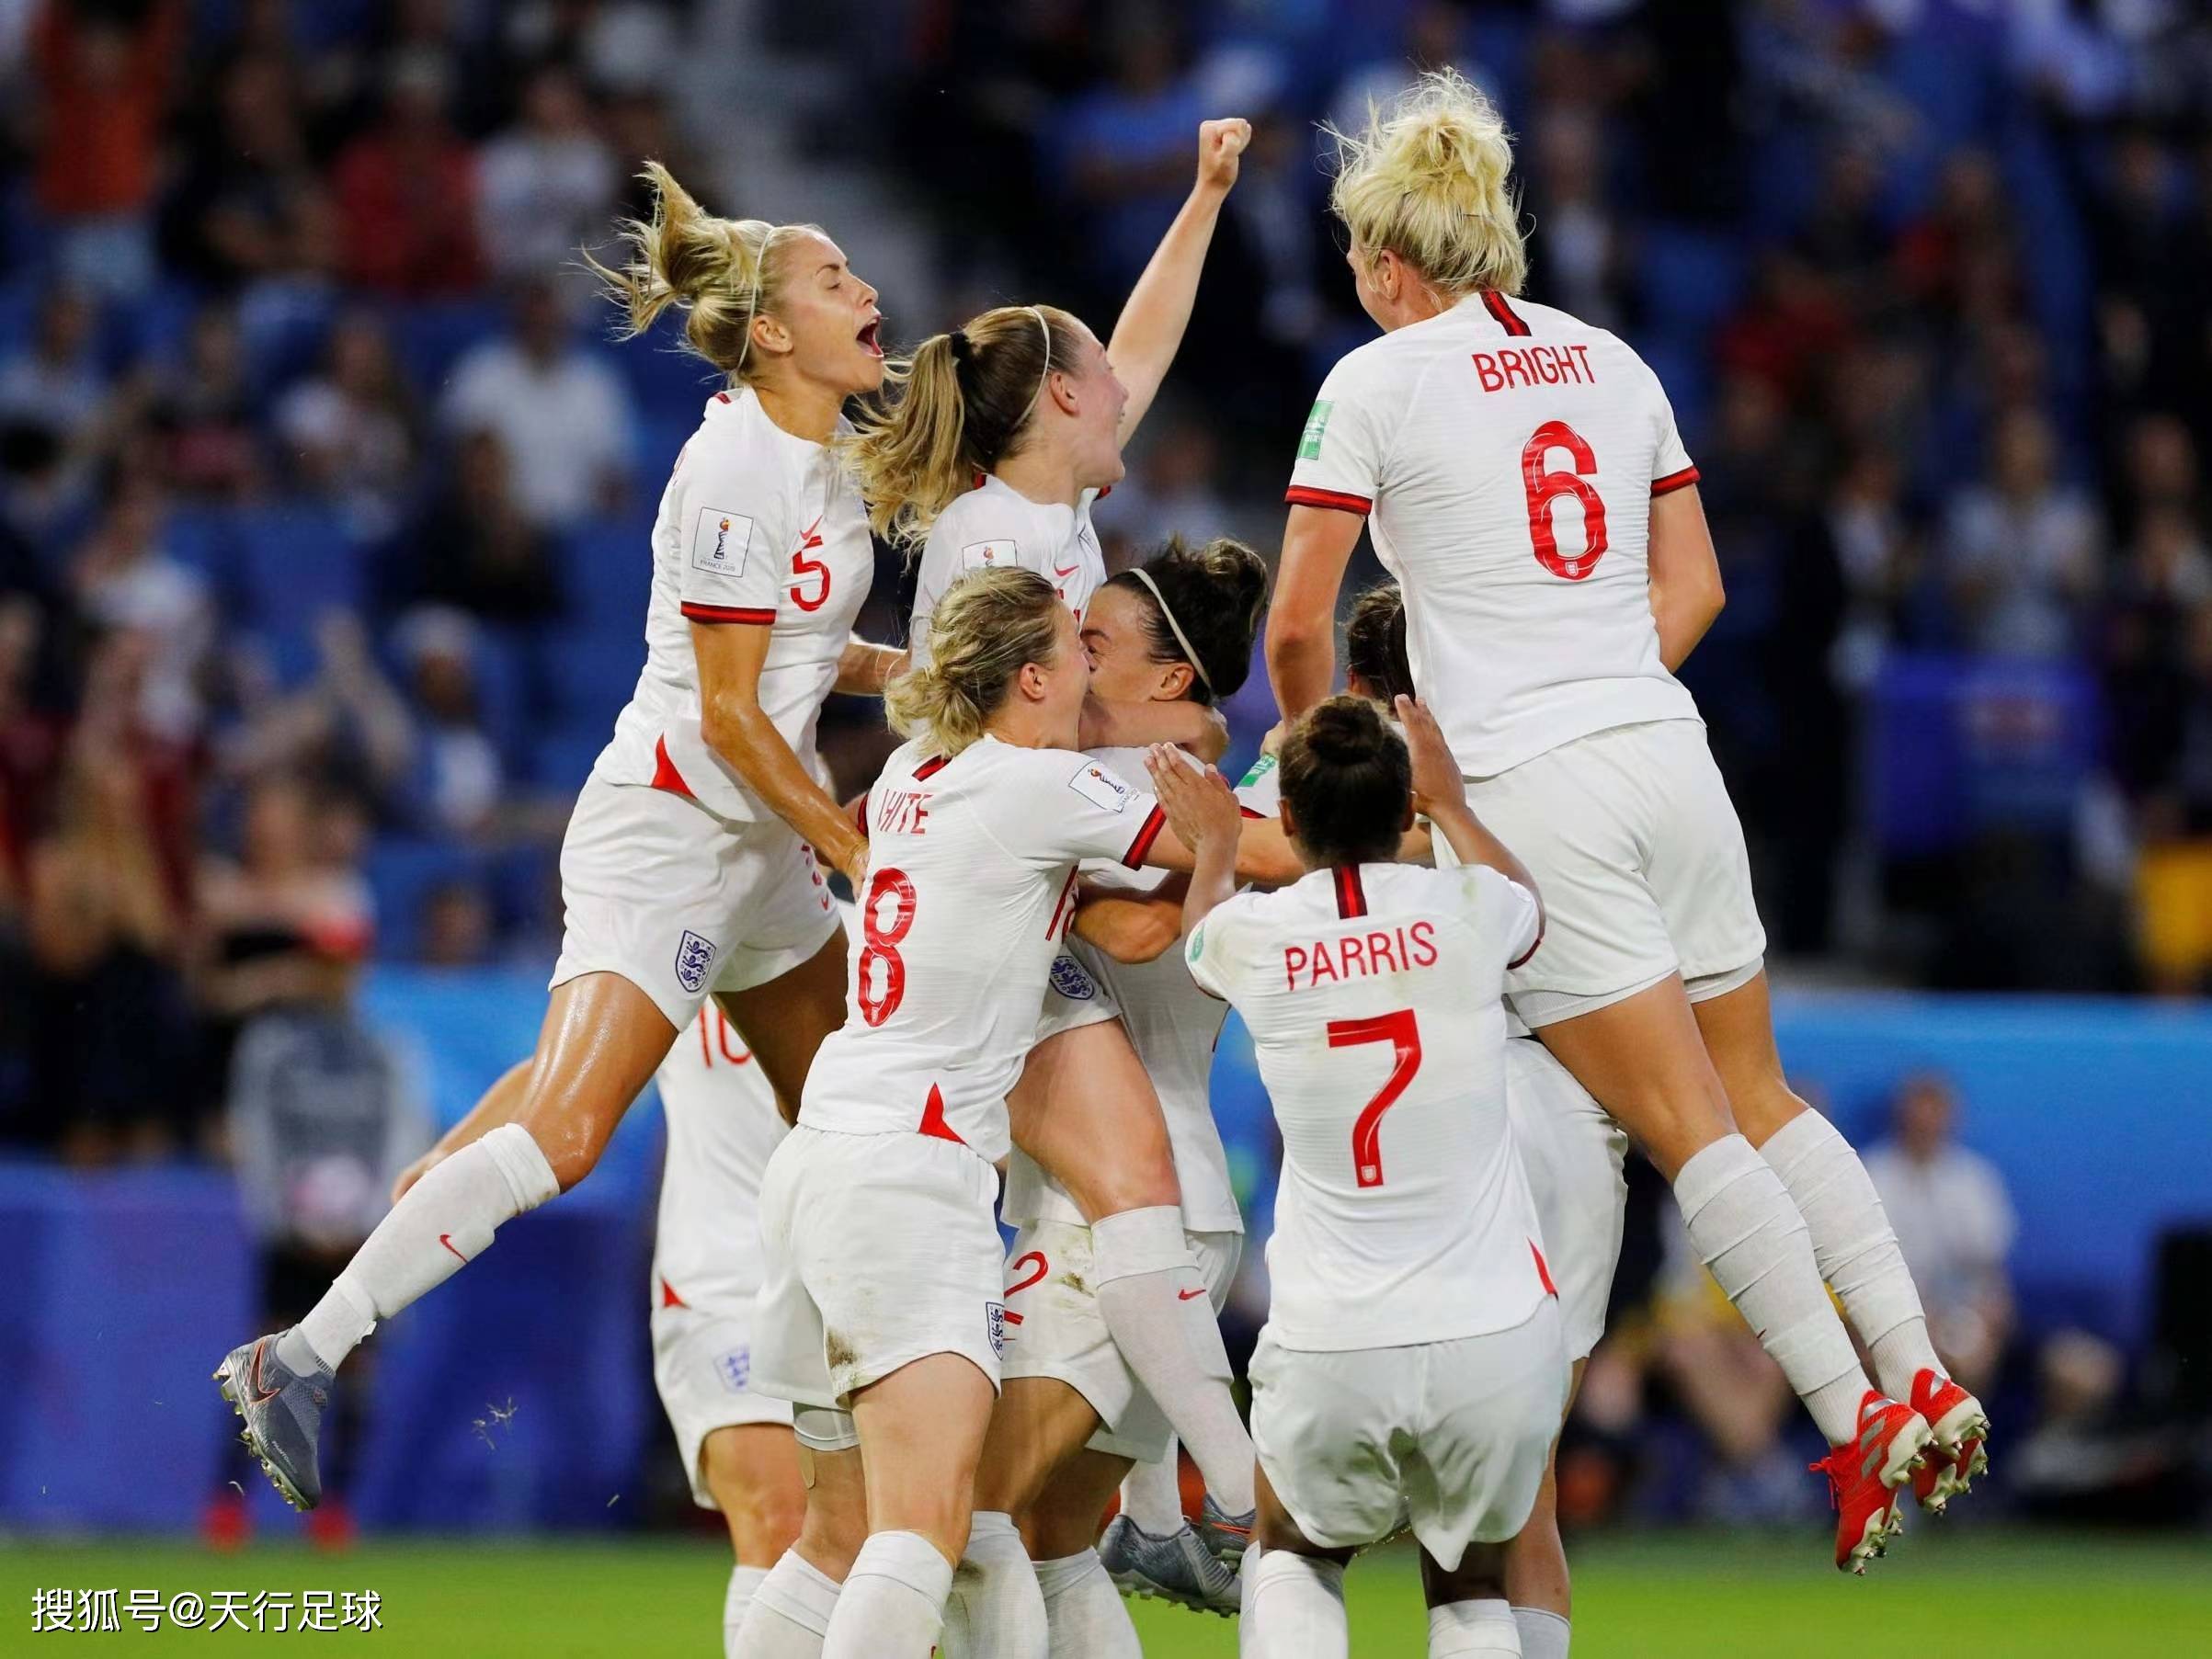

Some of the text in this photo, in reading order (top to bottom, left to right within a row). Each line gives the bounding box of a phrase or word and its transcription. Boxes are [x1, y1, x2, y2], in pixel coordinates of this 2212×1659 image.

[1472, 345, 1595, 392] BRIGHT
[1522, 421, 1607, 580] 6
[791, 535, 830, 611] 5
[858, 868, 917, 1027] 8
[1284, 921, 1438, 991] PARRIS
[1327, 1009, 1422, 1187] 7
